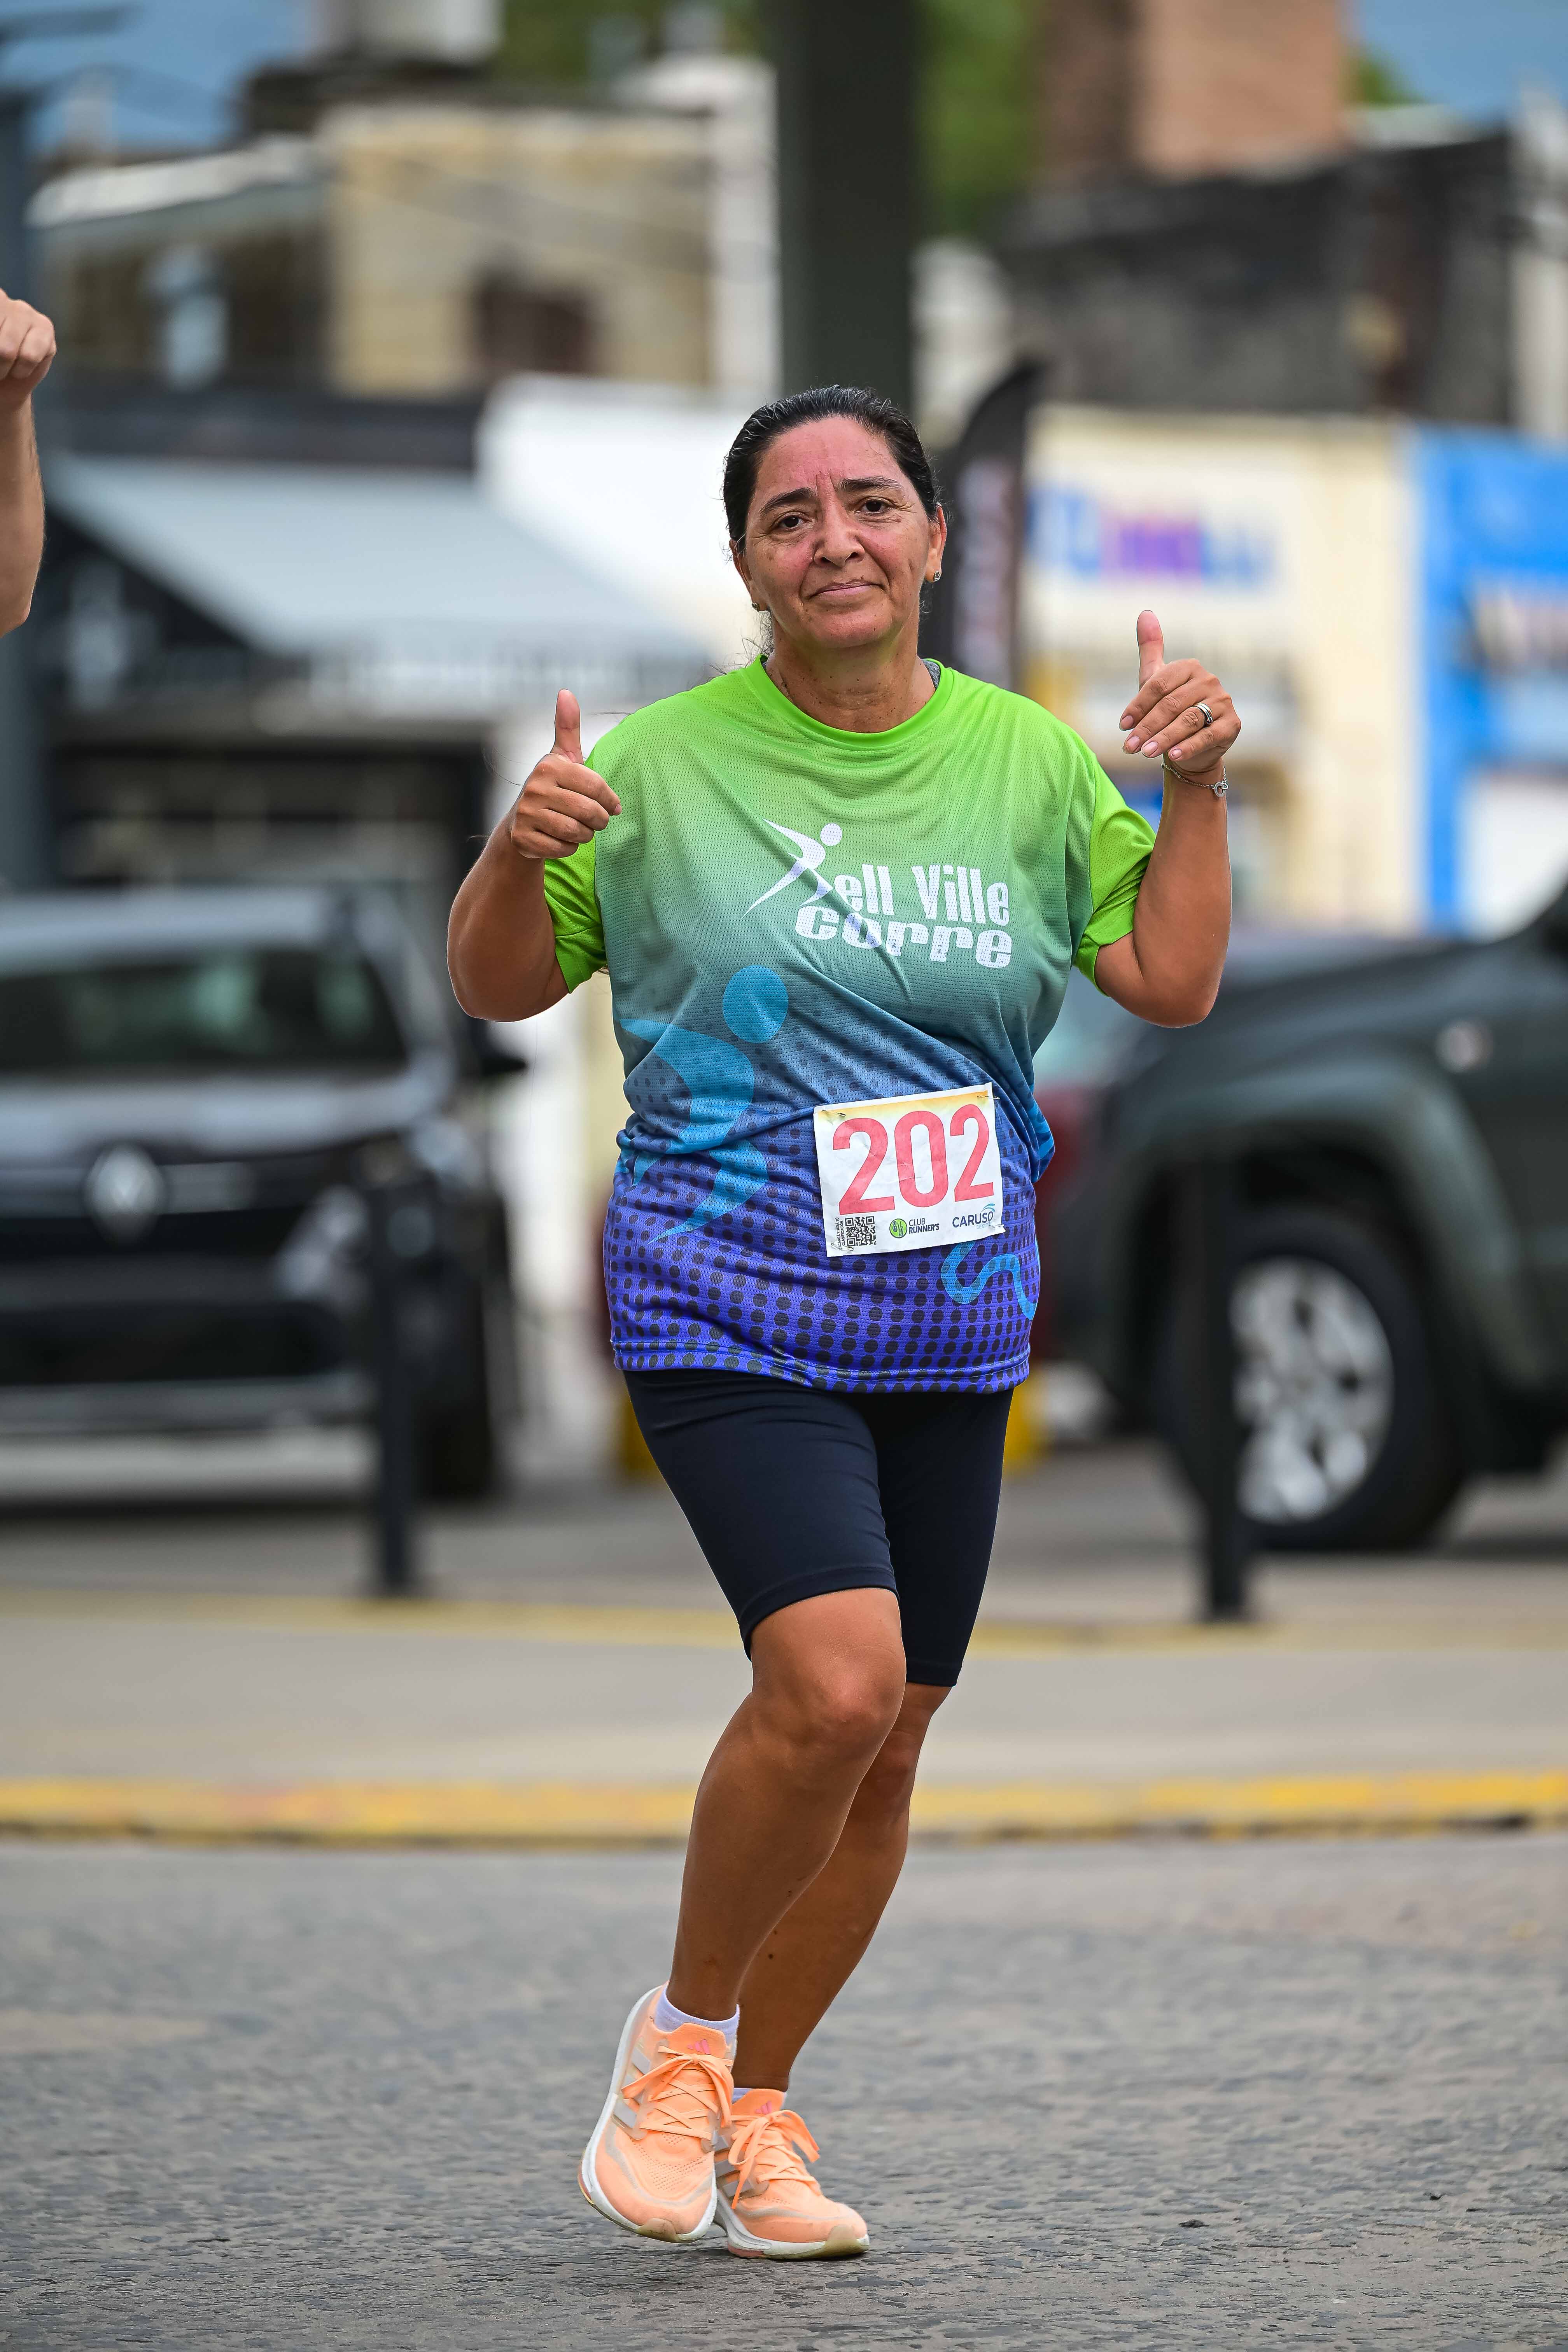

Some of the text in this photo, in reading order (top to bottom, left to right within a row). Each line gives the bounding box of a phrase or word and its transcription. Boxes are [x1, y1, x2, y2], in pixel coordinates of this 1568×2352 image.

[911, 864, 1009, 926] Ville
[795, 905, 1012, 968] corre
[833, 1104, 994, 1215] 202
[909, 1218, 926, 1226] CLUB
[909, 1223, 940, 1234] RUNNER'S
[952, 1211, 994, 1228] CARUSO
